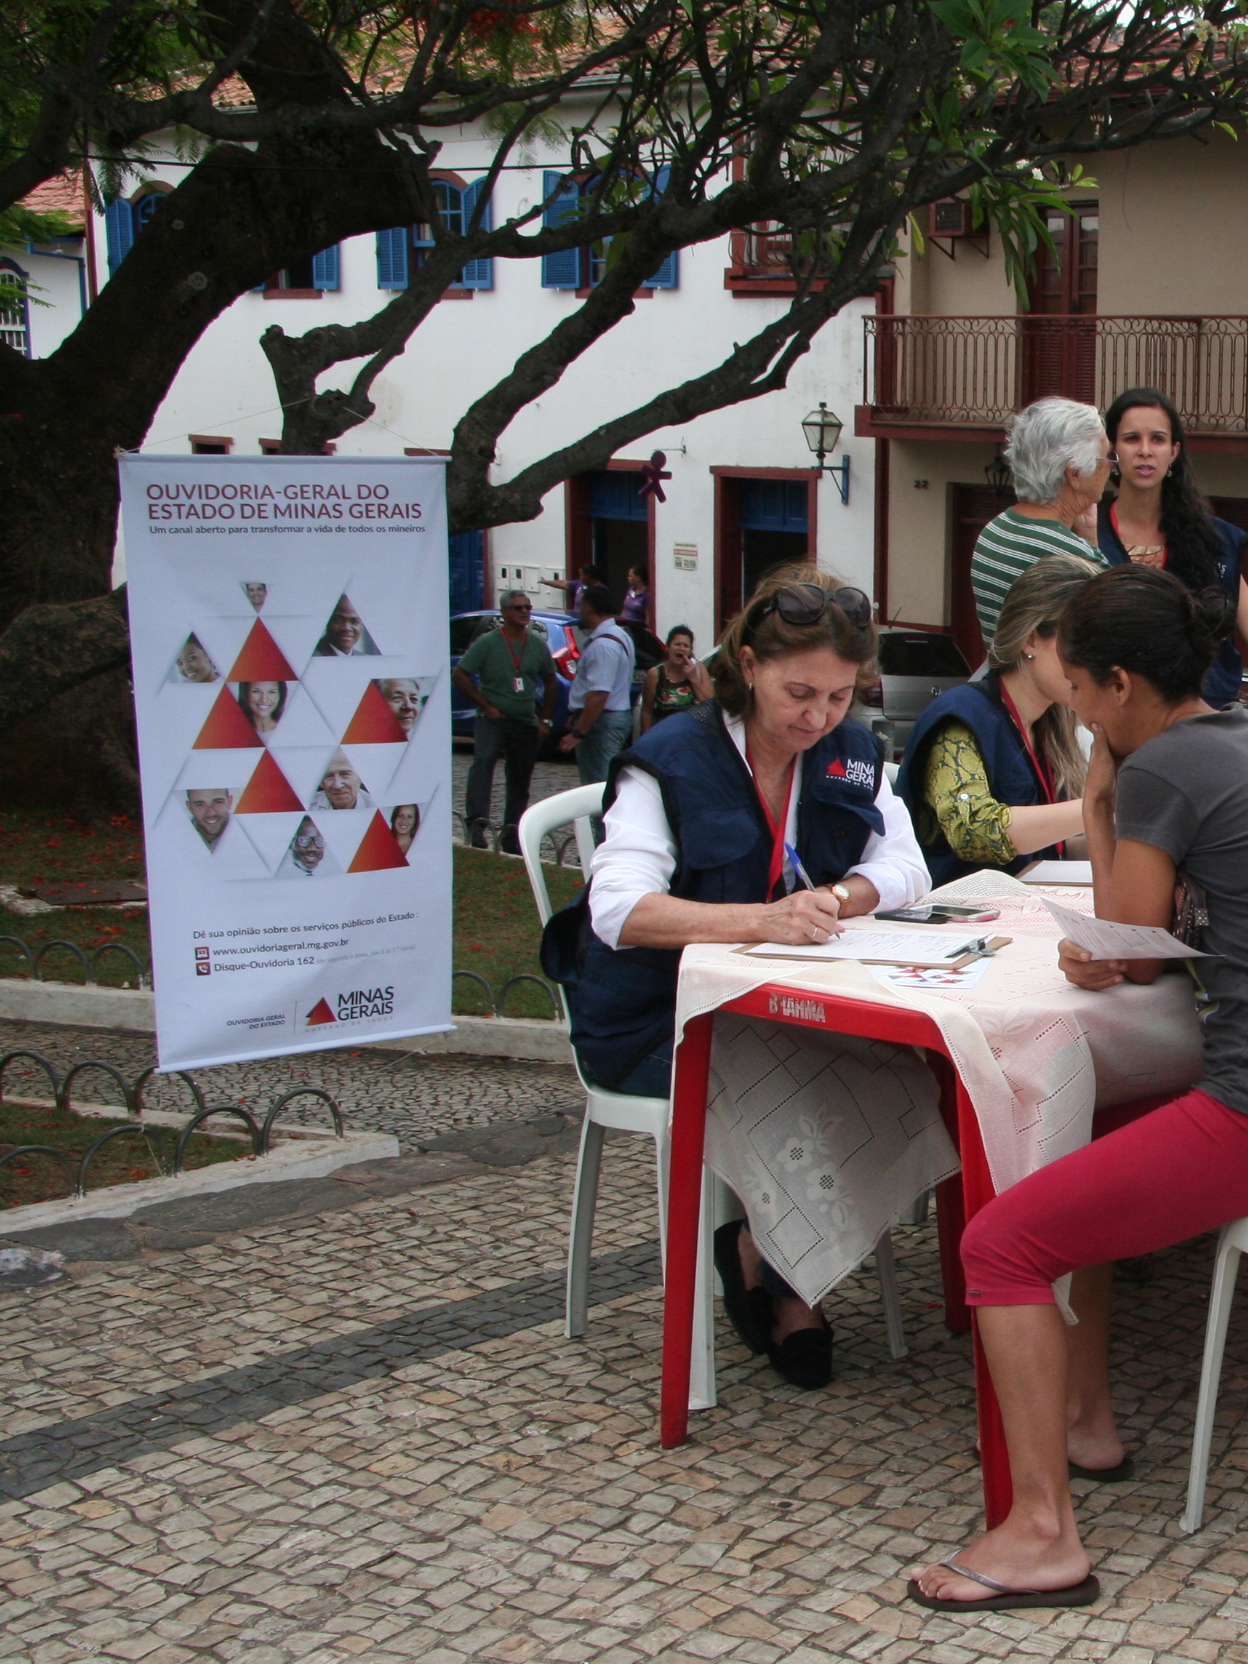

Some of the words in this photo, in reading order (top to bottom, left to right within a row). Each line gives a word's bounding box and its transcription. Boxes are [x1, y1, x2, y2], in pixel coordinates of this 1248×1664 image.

[146, 483, 352, 501] OUVIDORIA-GERAL
[357, 483, 390, 501] DO
[913, 479, 929, 490] 22
[147, 503, 235, 520] ESTADO
[240, 503, 269, 520] DE
[273, 503, 344, 519] MINAS
[348, 503, 422, 519] GERAIS
[149, 525, 167, 534] Um
[168, 525, 193, 534] canal
[195, 525, 226, 534] aberto
[228, 526, 249, 535] para
[250, 525, 305, 534] transformar
[313, 524, 333, 534] vida
[334, 525, 347, 533] de
[348, 525, 374, 533] todos
[375, 525, 387, 533] os
[388, 524, 426, 533] mineiros
[846, 758, 875, 776] MINA
[192, 930, 207, 940] Dê
[208, 931, 225, 939] sua
[226, 927, 261, 938] opinião
[263, 925, 289, 935] sobre
[290, 925, 301, 933] os
[302, 922, 340, 932] serviços
[341, 918, 375, 930] públicos
[376, 916, 387, 924] do
[388, 911, 415, 922] Estado
[212, 938, 350, 956] www.ouvidoriageral.mg.gov.br
[213, 957, 295, 973] Disque-Ouvidoria
[297, 956, 315, 966] 162
[338, 986, 395, 1008] MINAS
[226, 1016, 265, 1027] OUVIDORIA
[265, 1013, 286, 1021] GERAL
[337, 1001, 394, 1022] GERAIS
[248, 1022, 259, 1030] DO
[260, 1019, 286, 1029] ESTADO
